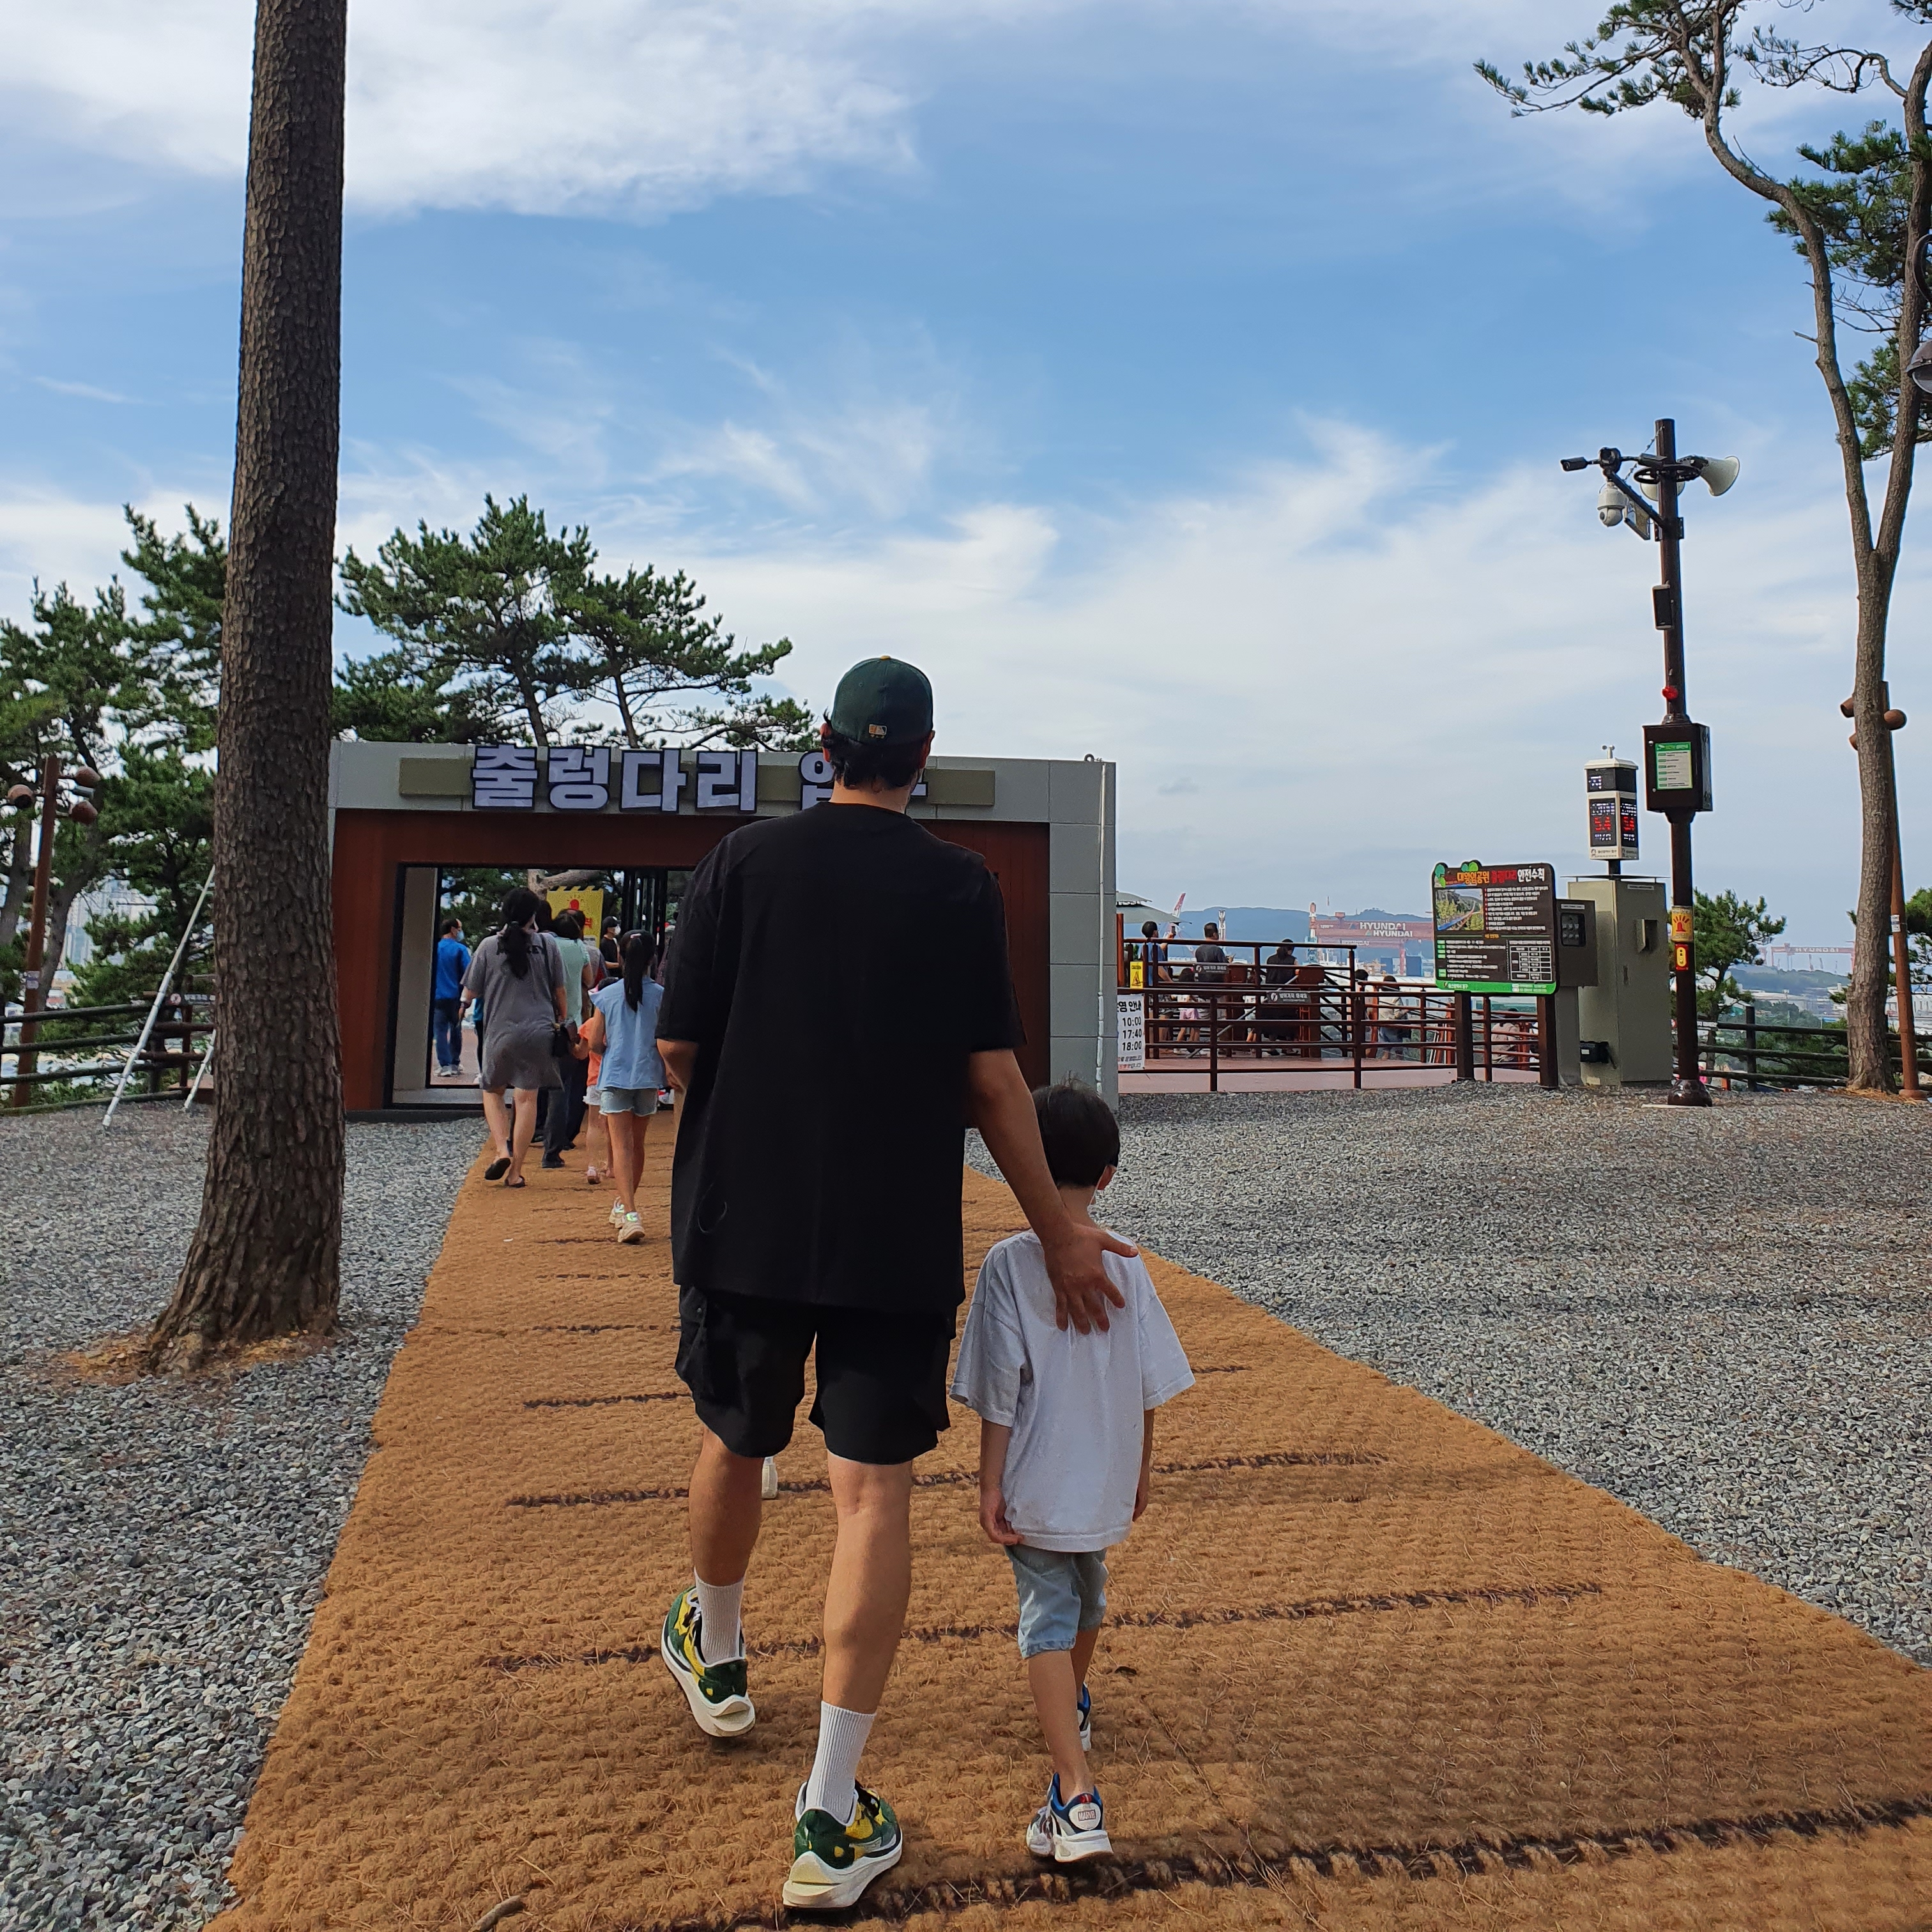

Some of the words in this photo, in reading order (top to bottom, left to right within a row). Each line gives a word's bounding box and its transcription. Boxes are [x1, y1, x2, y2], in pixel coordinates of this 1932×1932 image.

[471, 744, 758, 813] 출렁다리
[1517, 868, 1545, 882] 안전수칙
[1360, 922, 1406, 930] HYUNDAI
[1117, 1001, 1128, 1012] 영
[1123, 1016, 1142, 1027] 10:00
[1123, 1029, 1142, 1039] 17:40
[1122, 1041, 1142, 1052] 18:00
